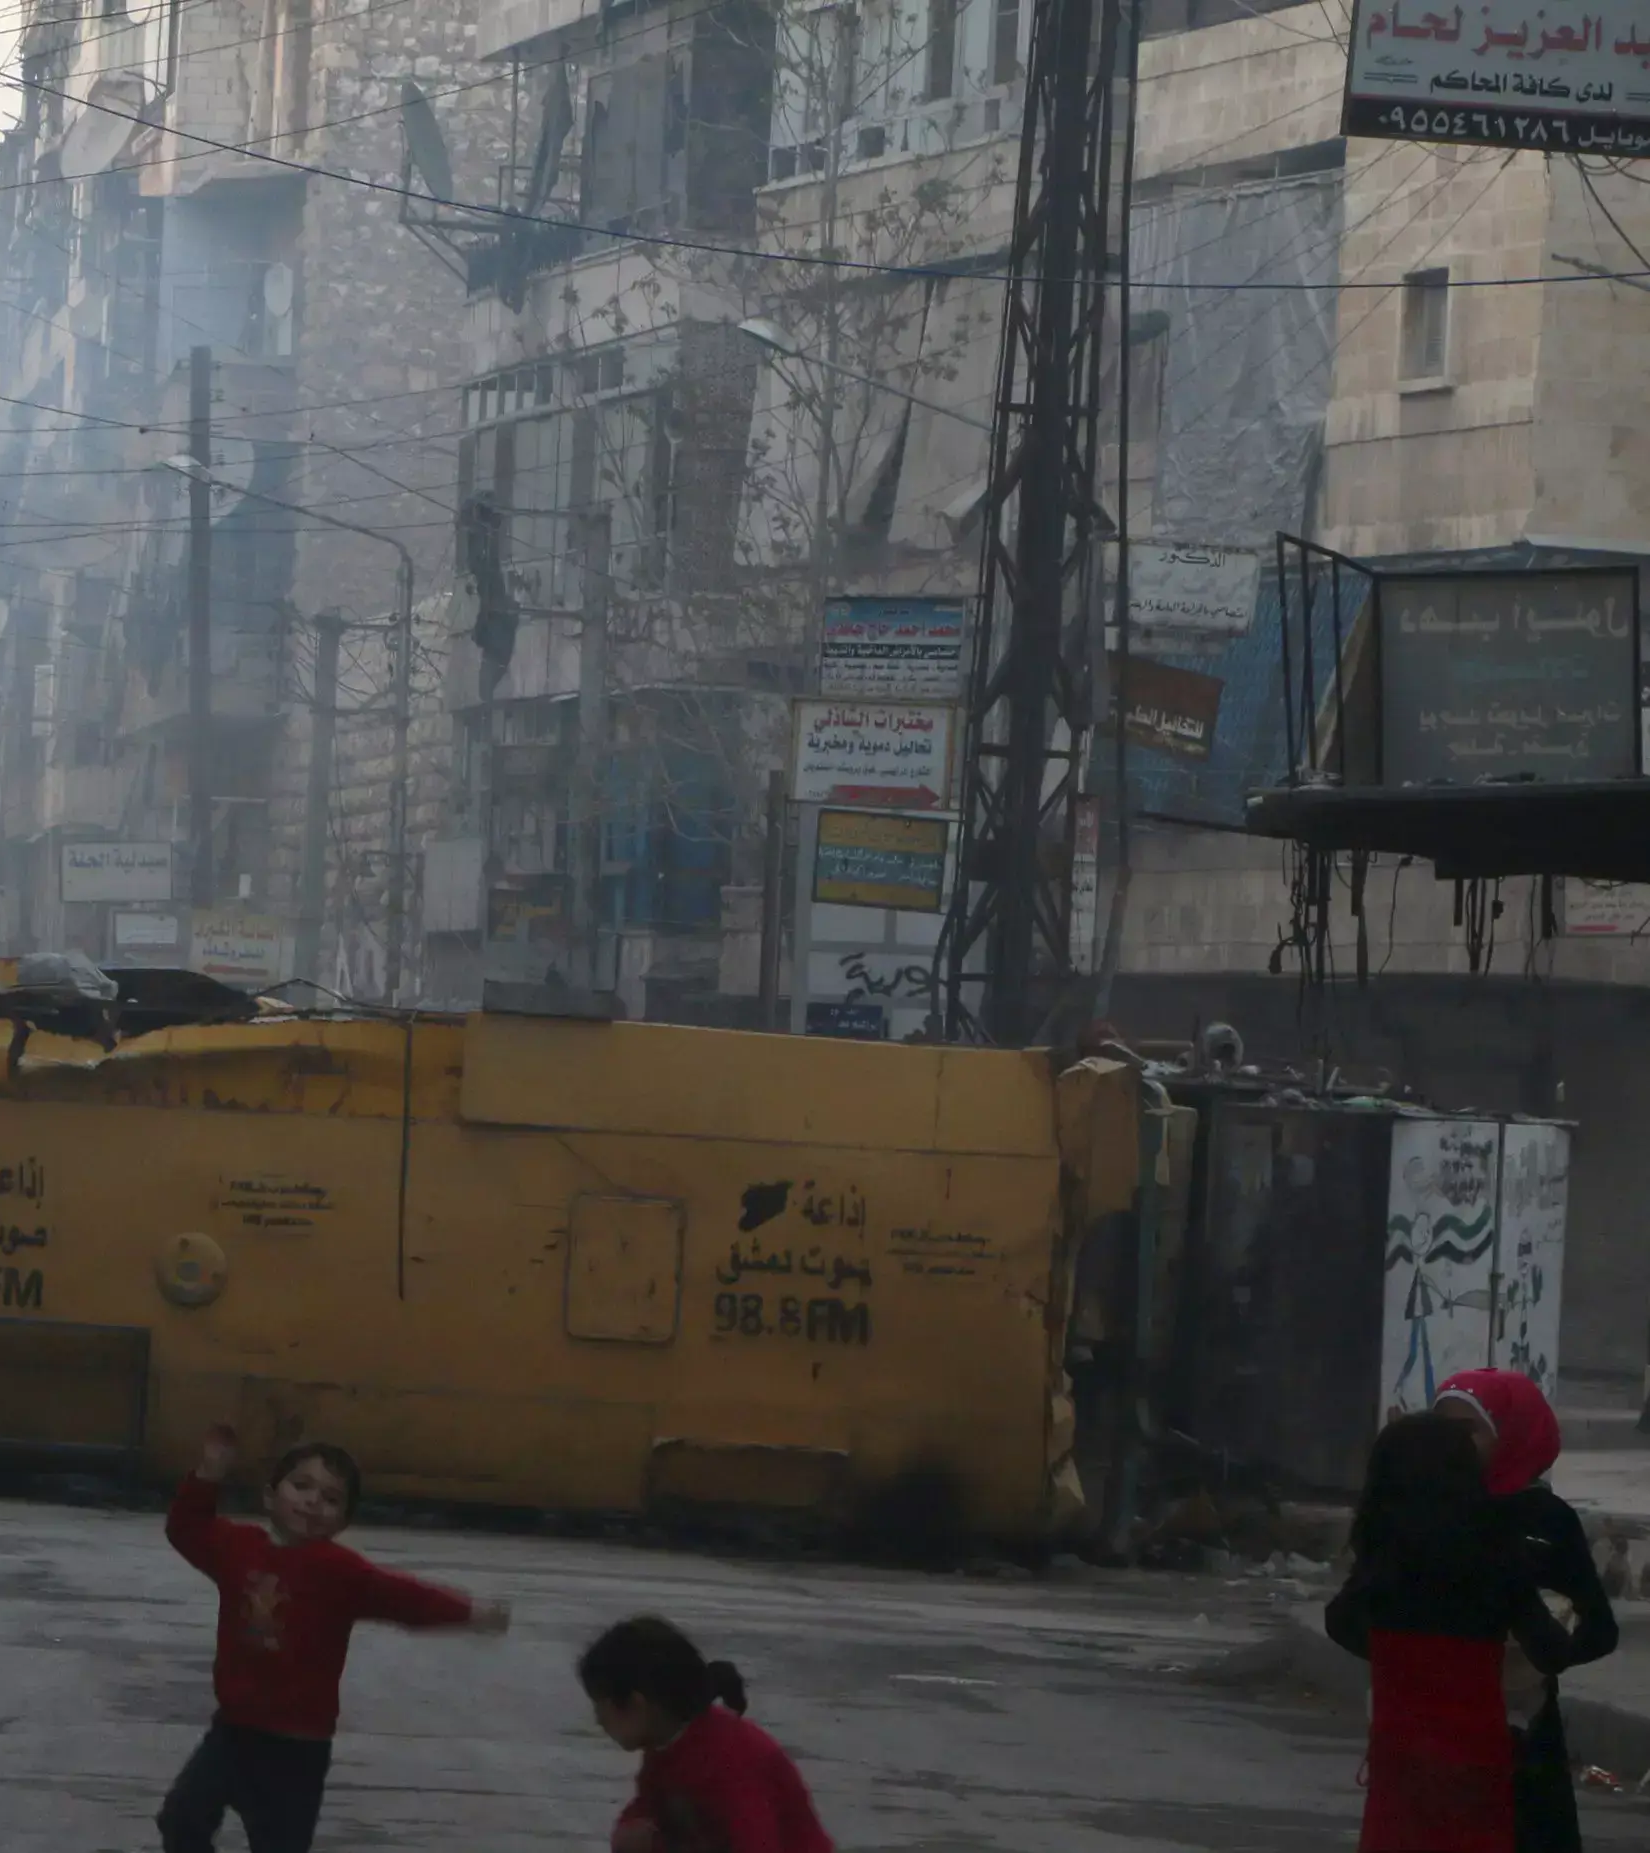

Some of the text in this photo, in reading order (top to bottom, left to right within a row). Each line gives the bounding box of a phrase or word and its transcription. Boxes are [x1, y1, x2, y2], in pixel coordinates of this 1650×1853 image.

[1366, 1, 1650, 69] بد العزيز لحام
[1429, 69, 1508, 96] المحاكم
[1512, 71, 1571, 100] كافة
[1158, 549, 1226, 568] الدكتور
[873, 708, 934, 733] مختبرات
[894, 738, 932, 757] تحاليل
[800, 1178, 867, 1241] إذاعة
[799, 1245, 873, 1290] صوت
[713, 1291, 872, 1347] 98.8FM
